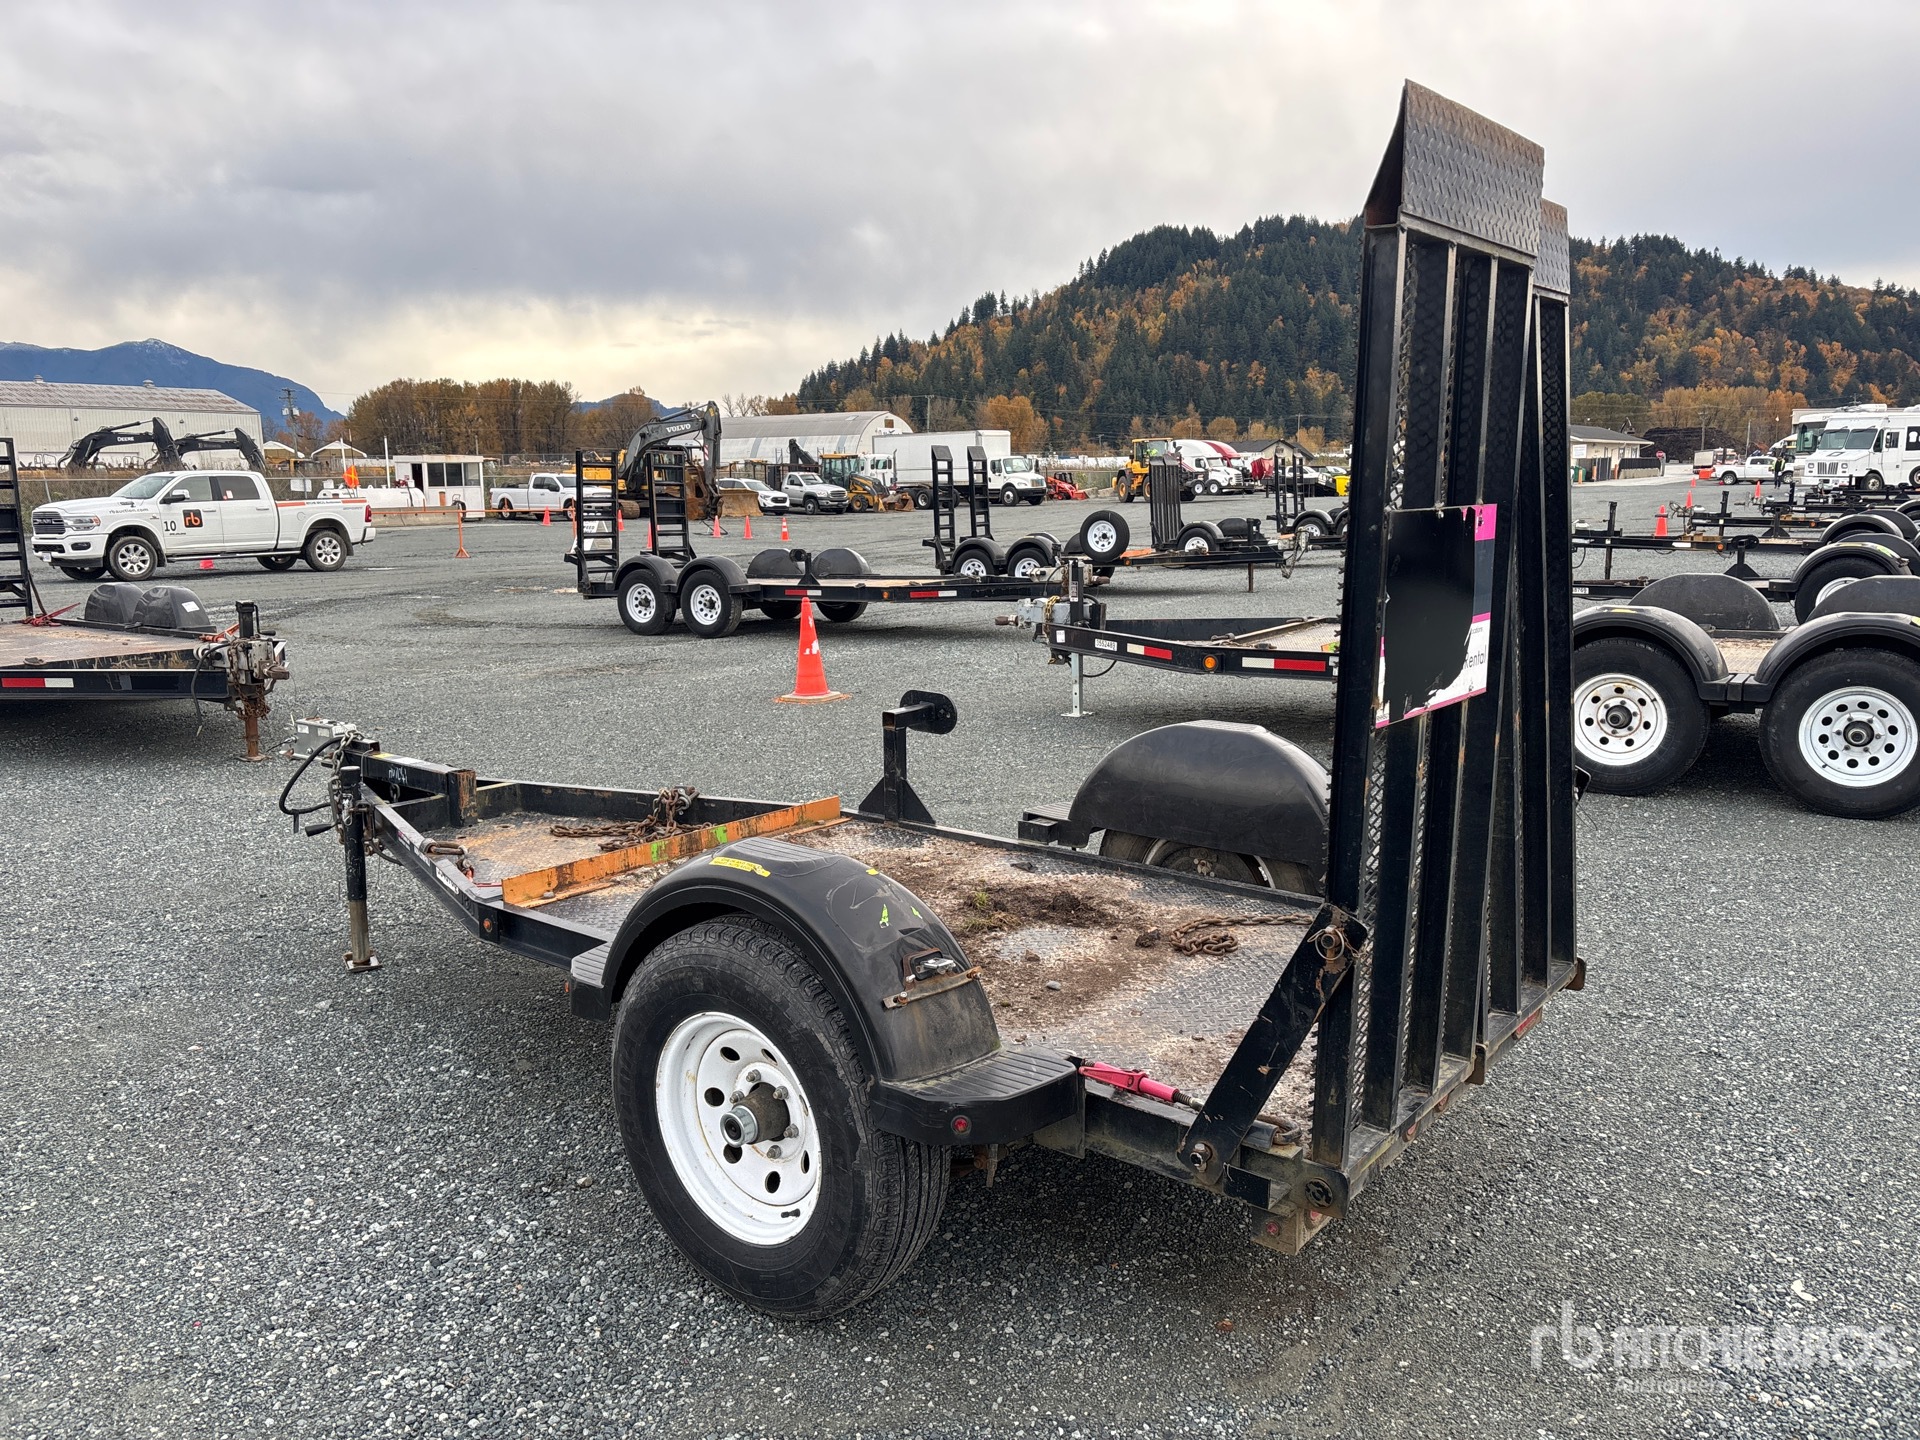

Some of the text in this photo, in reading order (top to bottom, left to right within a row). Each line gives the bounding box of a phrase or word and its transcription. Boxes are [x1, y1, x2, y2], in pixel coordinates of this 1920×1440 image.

[666, 423, 692, 433] VOLVO
[185, 512, 201, 527] rb
[164, 520, 177, 532] 10
